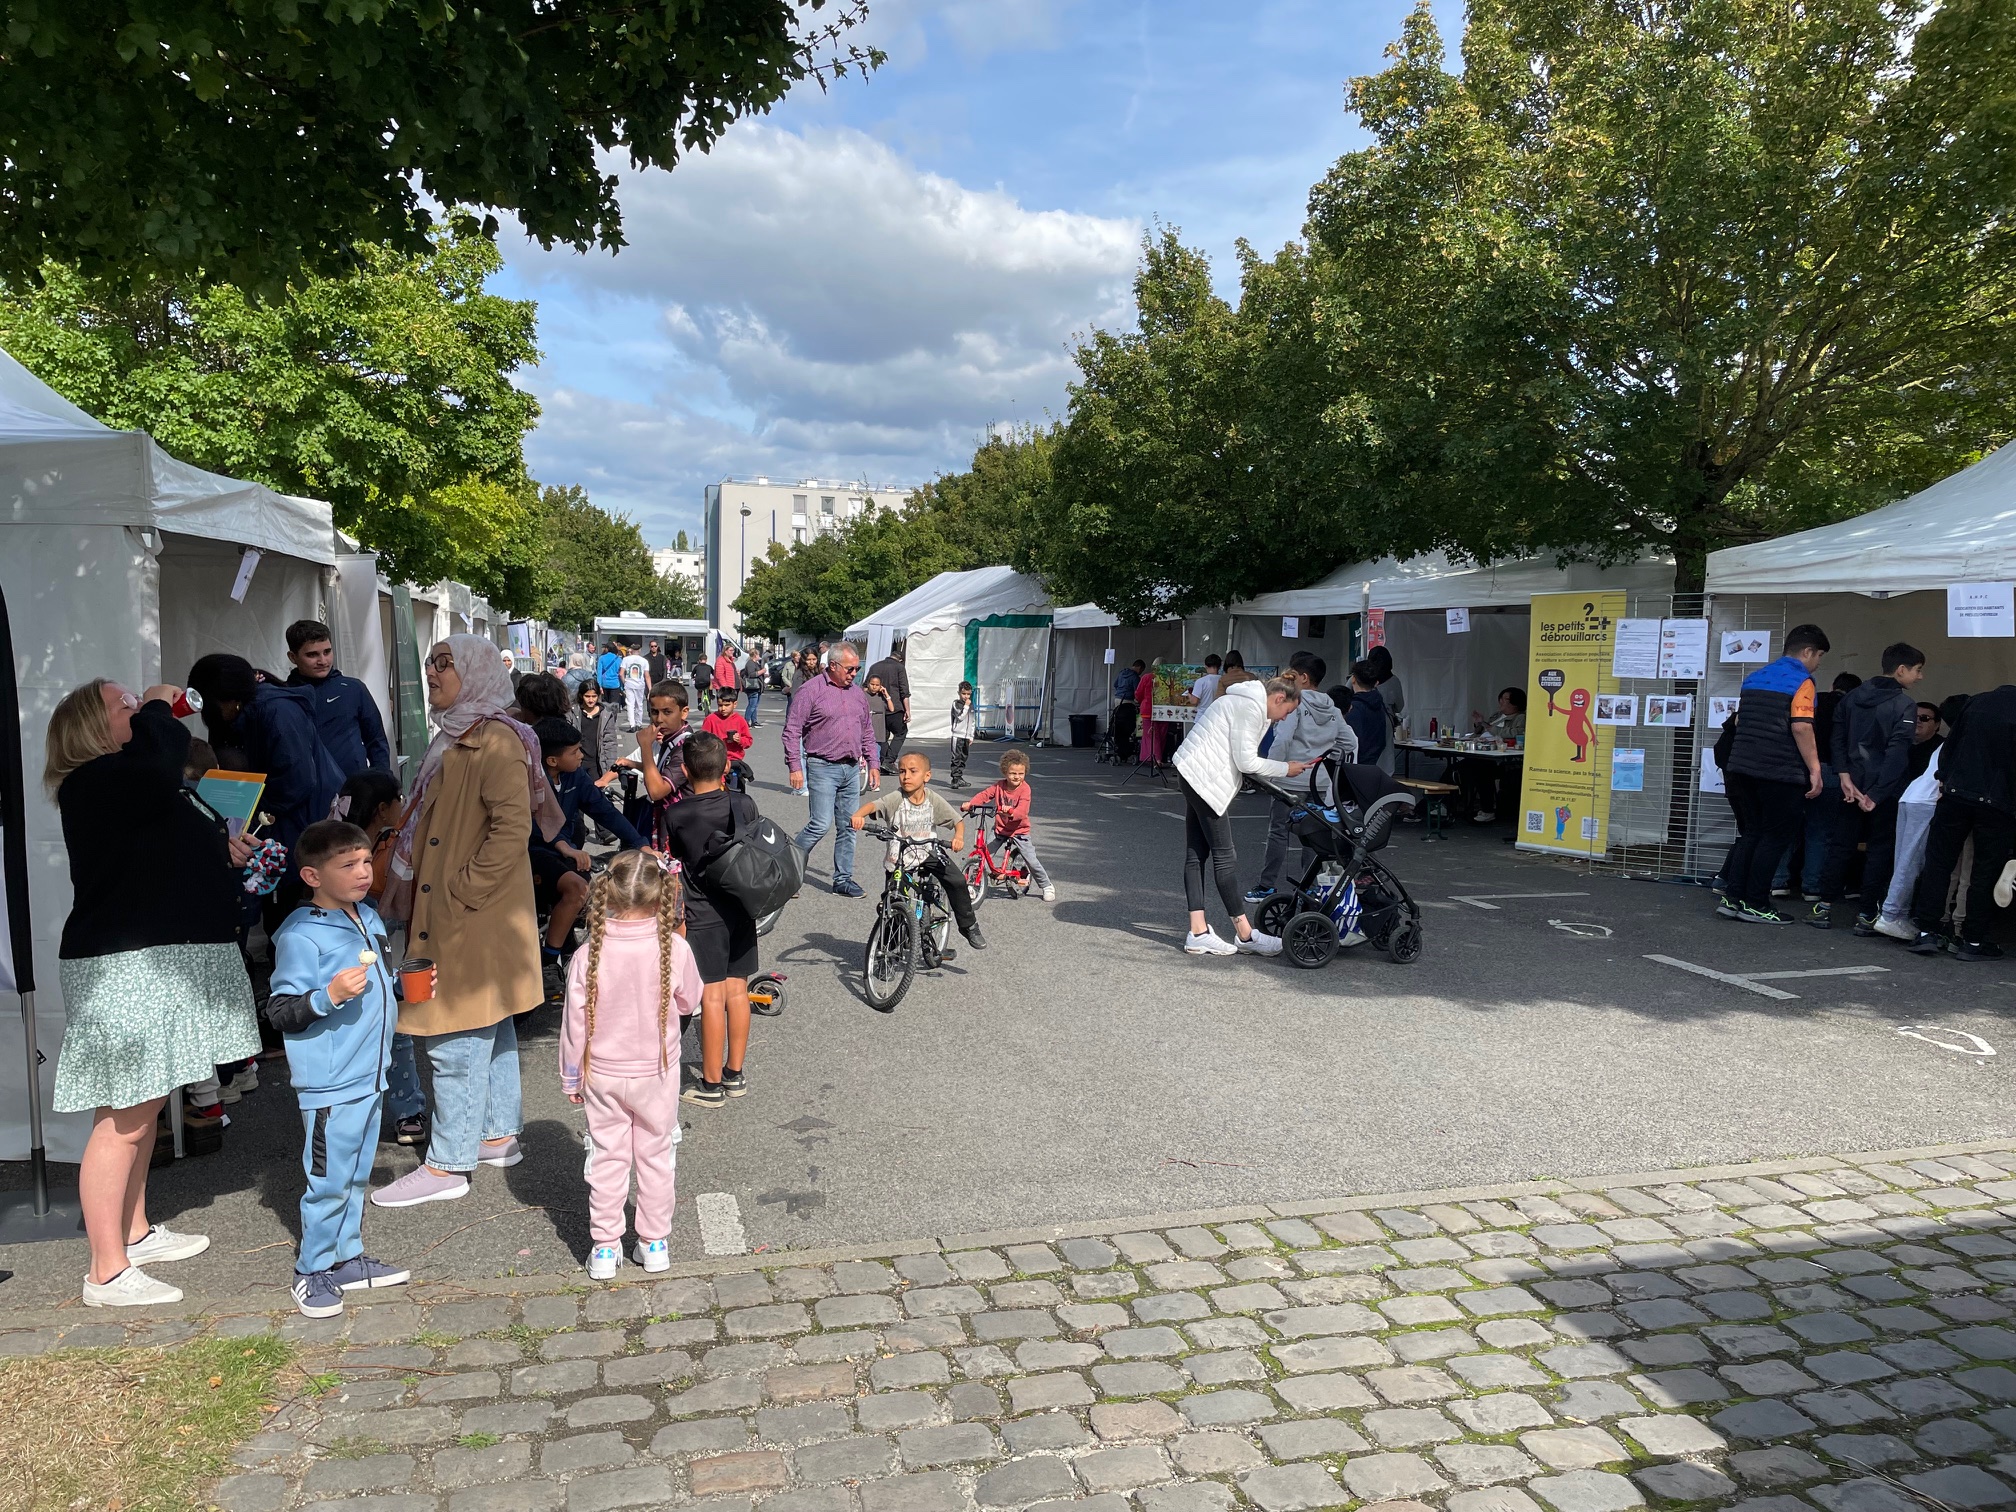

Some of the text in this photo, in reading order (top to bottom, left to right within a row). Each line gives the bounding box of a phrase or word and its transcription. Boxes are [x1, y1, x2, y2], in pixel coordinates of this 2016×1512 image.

[1541, 621, 1585, 632] les petits
[1541, 632, 1606, 641] débrouillards
